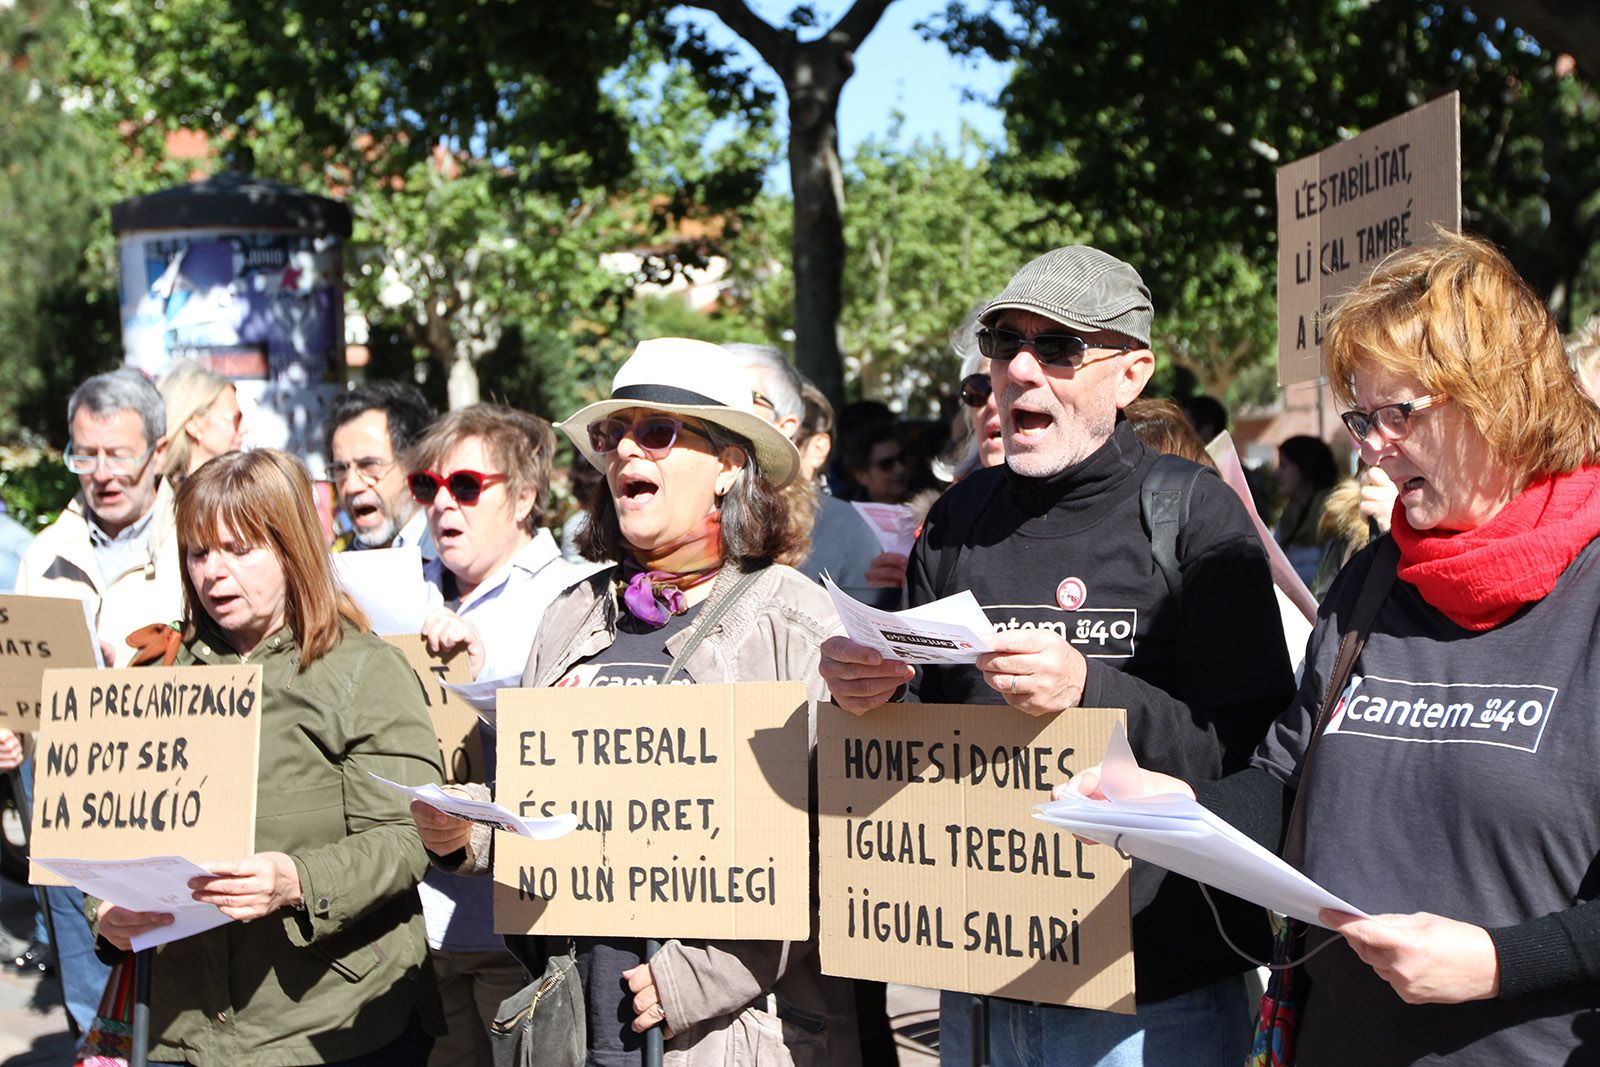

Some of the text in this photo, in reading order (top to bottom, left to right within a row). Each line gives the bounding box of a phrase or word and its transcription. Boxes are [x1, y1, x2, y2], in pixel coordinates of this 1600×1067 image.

[1319, 237, 1350, 276] CAL
[1356, 198, 1412, 264] TAMBÉ
[1296, 314, 1306, 350] A
[0, 638, 51, 659] ATS
[51, 685, 78, 722] LA
[47, 737, 188, 777] NO POT SER
[519, 726, 718, 767] EL TREBALL
[844, 738, 945, 784] HOMES
[970, 745, 1076, 792] DONES
[41, 792, 71, 829] LA
[570, 799, 613, 831] UN
[628, 798, 720, 840] DRET,
[945, 823, 1096, 880] TREBALL
[518, 865, 558, 901] NO
[570, 865, 614, 903] UN
